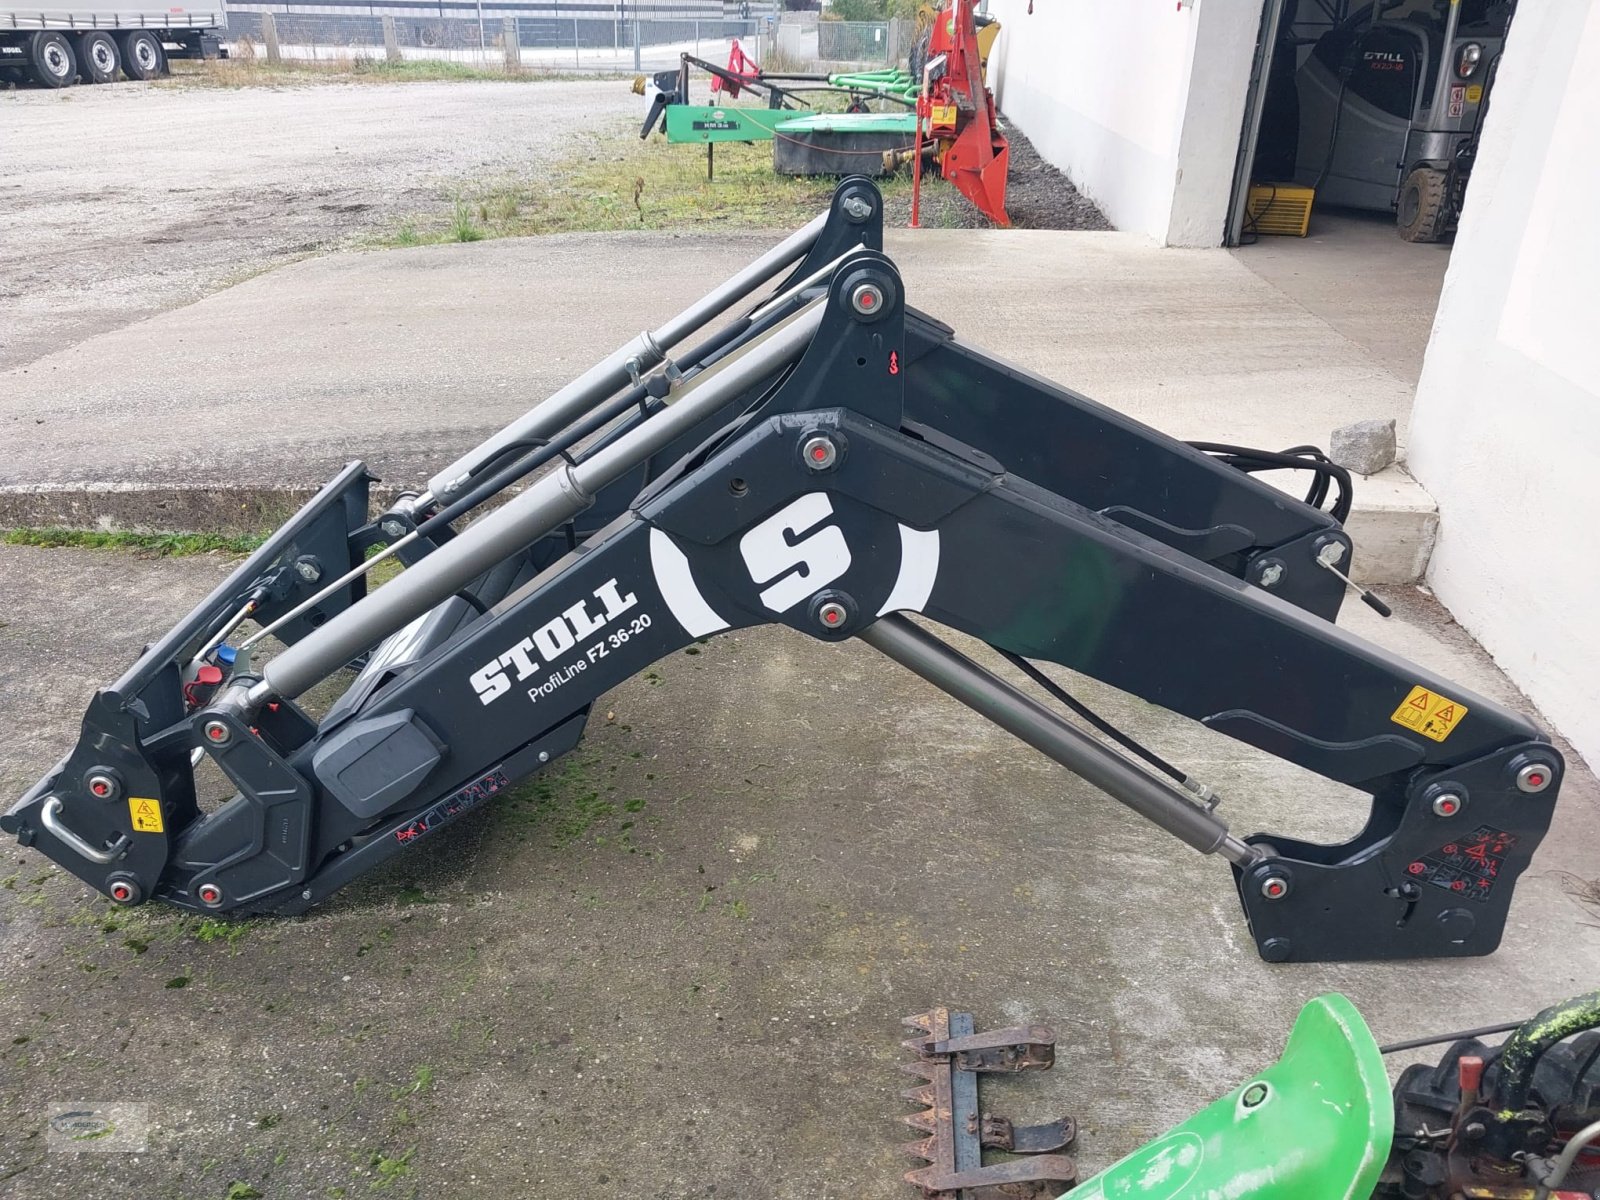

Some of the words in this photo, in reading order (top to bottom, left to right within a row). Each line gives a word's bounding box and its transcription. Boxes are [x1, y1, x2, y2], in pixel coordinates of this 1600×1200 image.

[1364, 51, 1404, 62] STILL
[739, 491, 852, 613] S
[469, 578, 638, 706] STOLL
[527, 658, 587, 703] ProfiLine
[586, 641, 610, 664] FZ
[608, 613, 652, 648] 36-20
